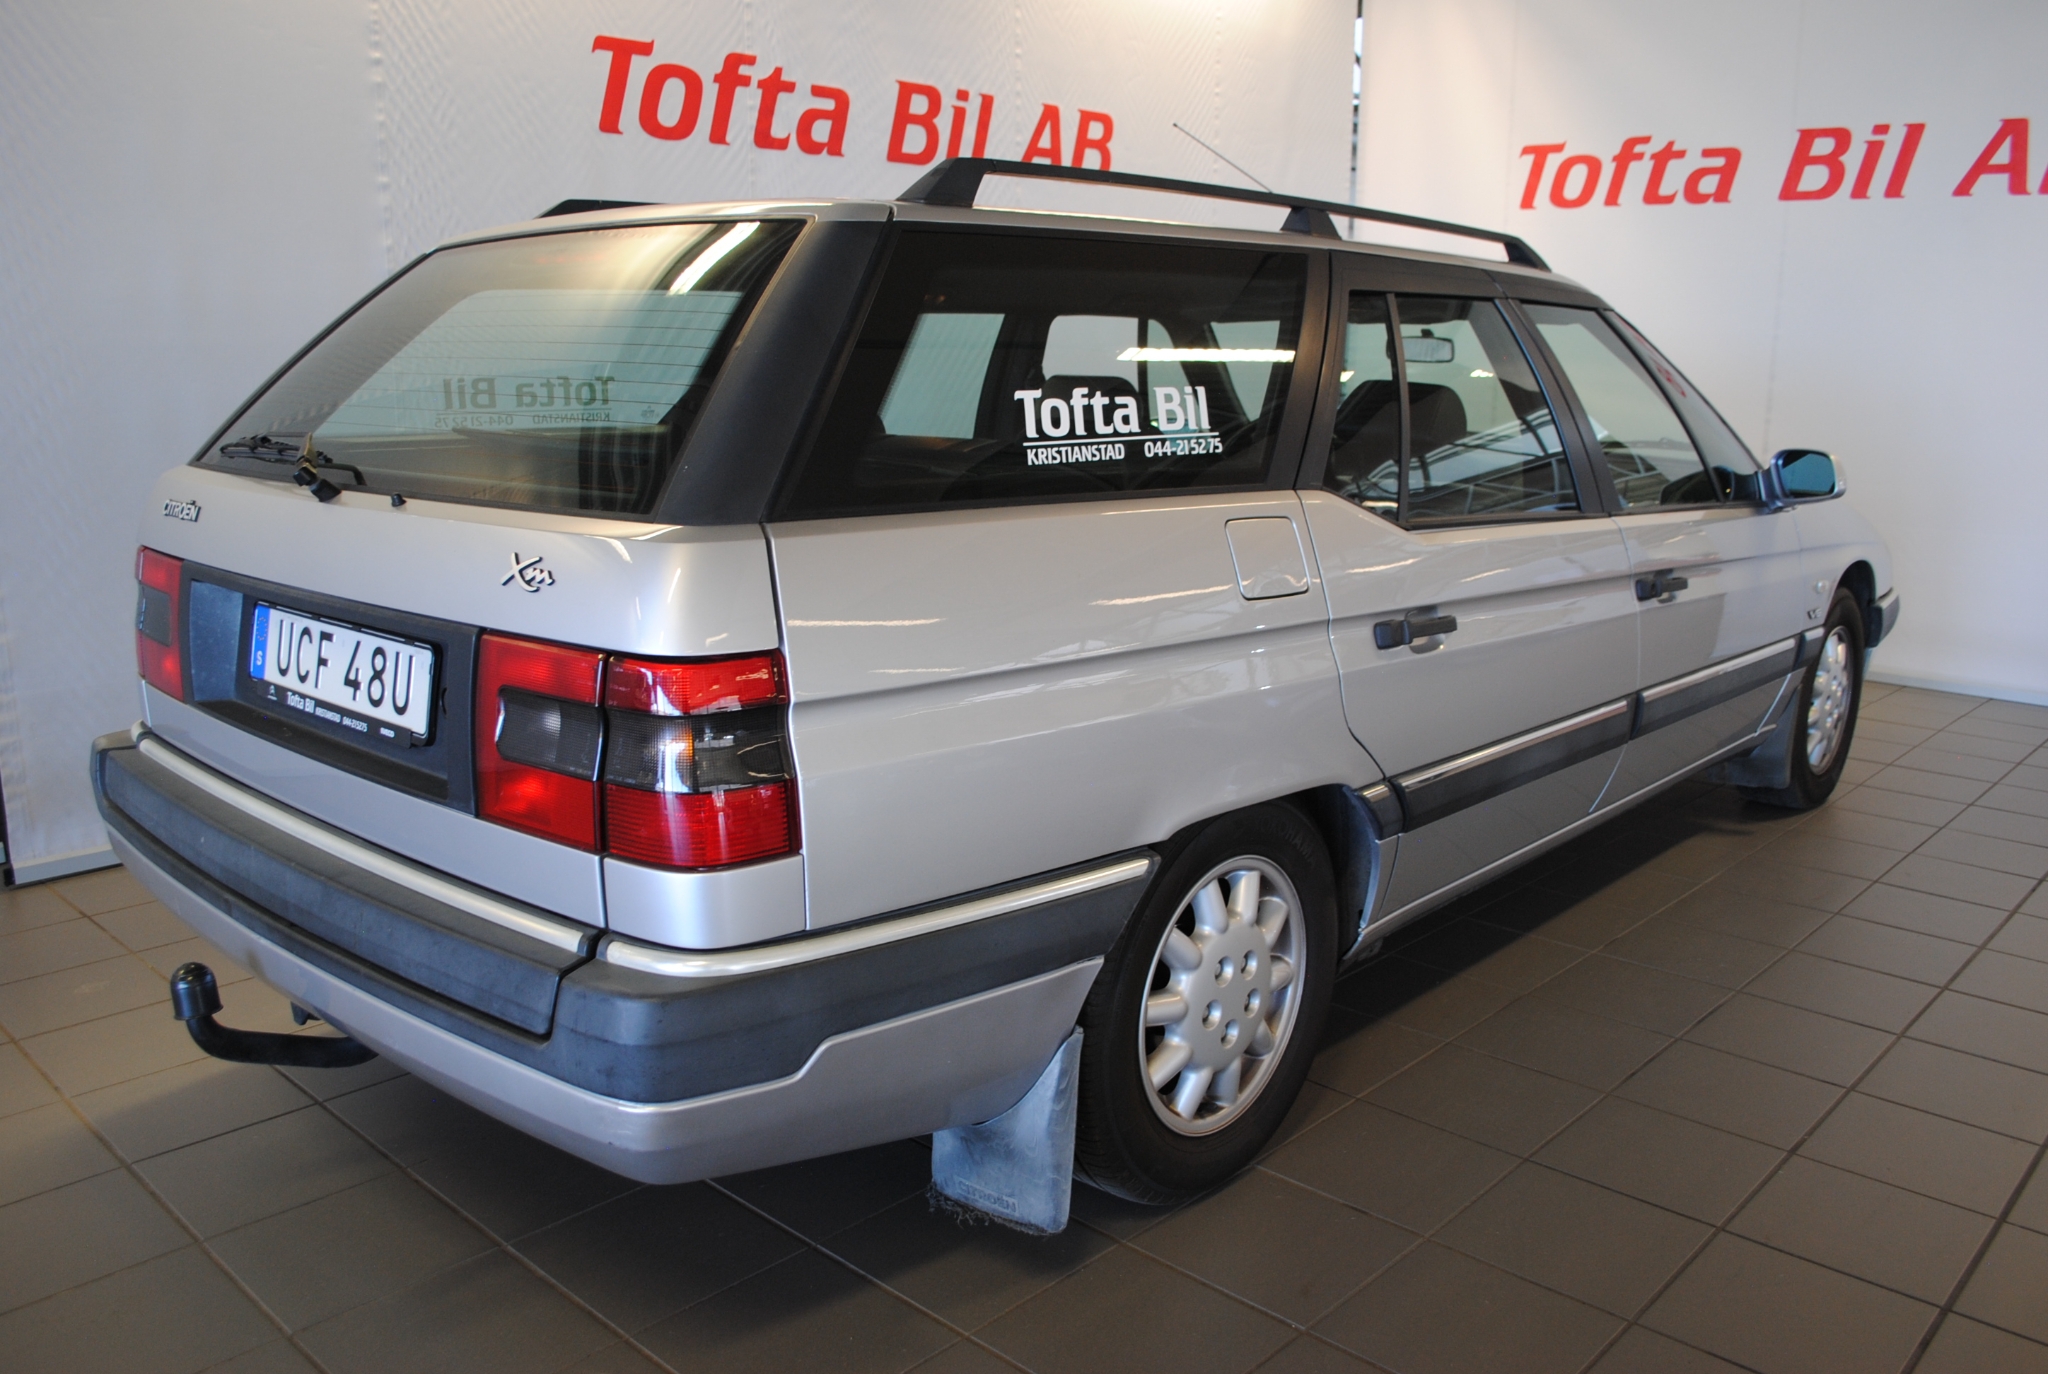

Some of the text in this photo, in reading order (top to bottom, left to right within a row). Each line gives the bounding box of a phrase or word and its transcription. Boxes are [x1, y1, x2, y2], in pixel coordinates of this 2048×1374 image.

[591, 34, 1115, 172] Tofta Bil AB
[1519, 117, 2048, 210] Tofta Bil A
[1014, 386, 1212, 439] Tofta Bil
[1027, 443, 1125, 466] KRISTIANSTAD
[255, 650, 263, 666] S
[277, 619, 415, 716] UCF 48U
[286, 691, 305, 710] Tofta
[304, 697, 316, 713] Bil
